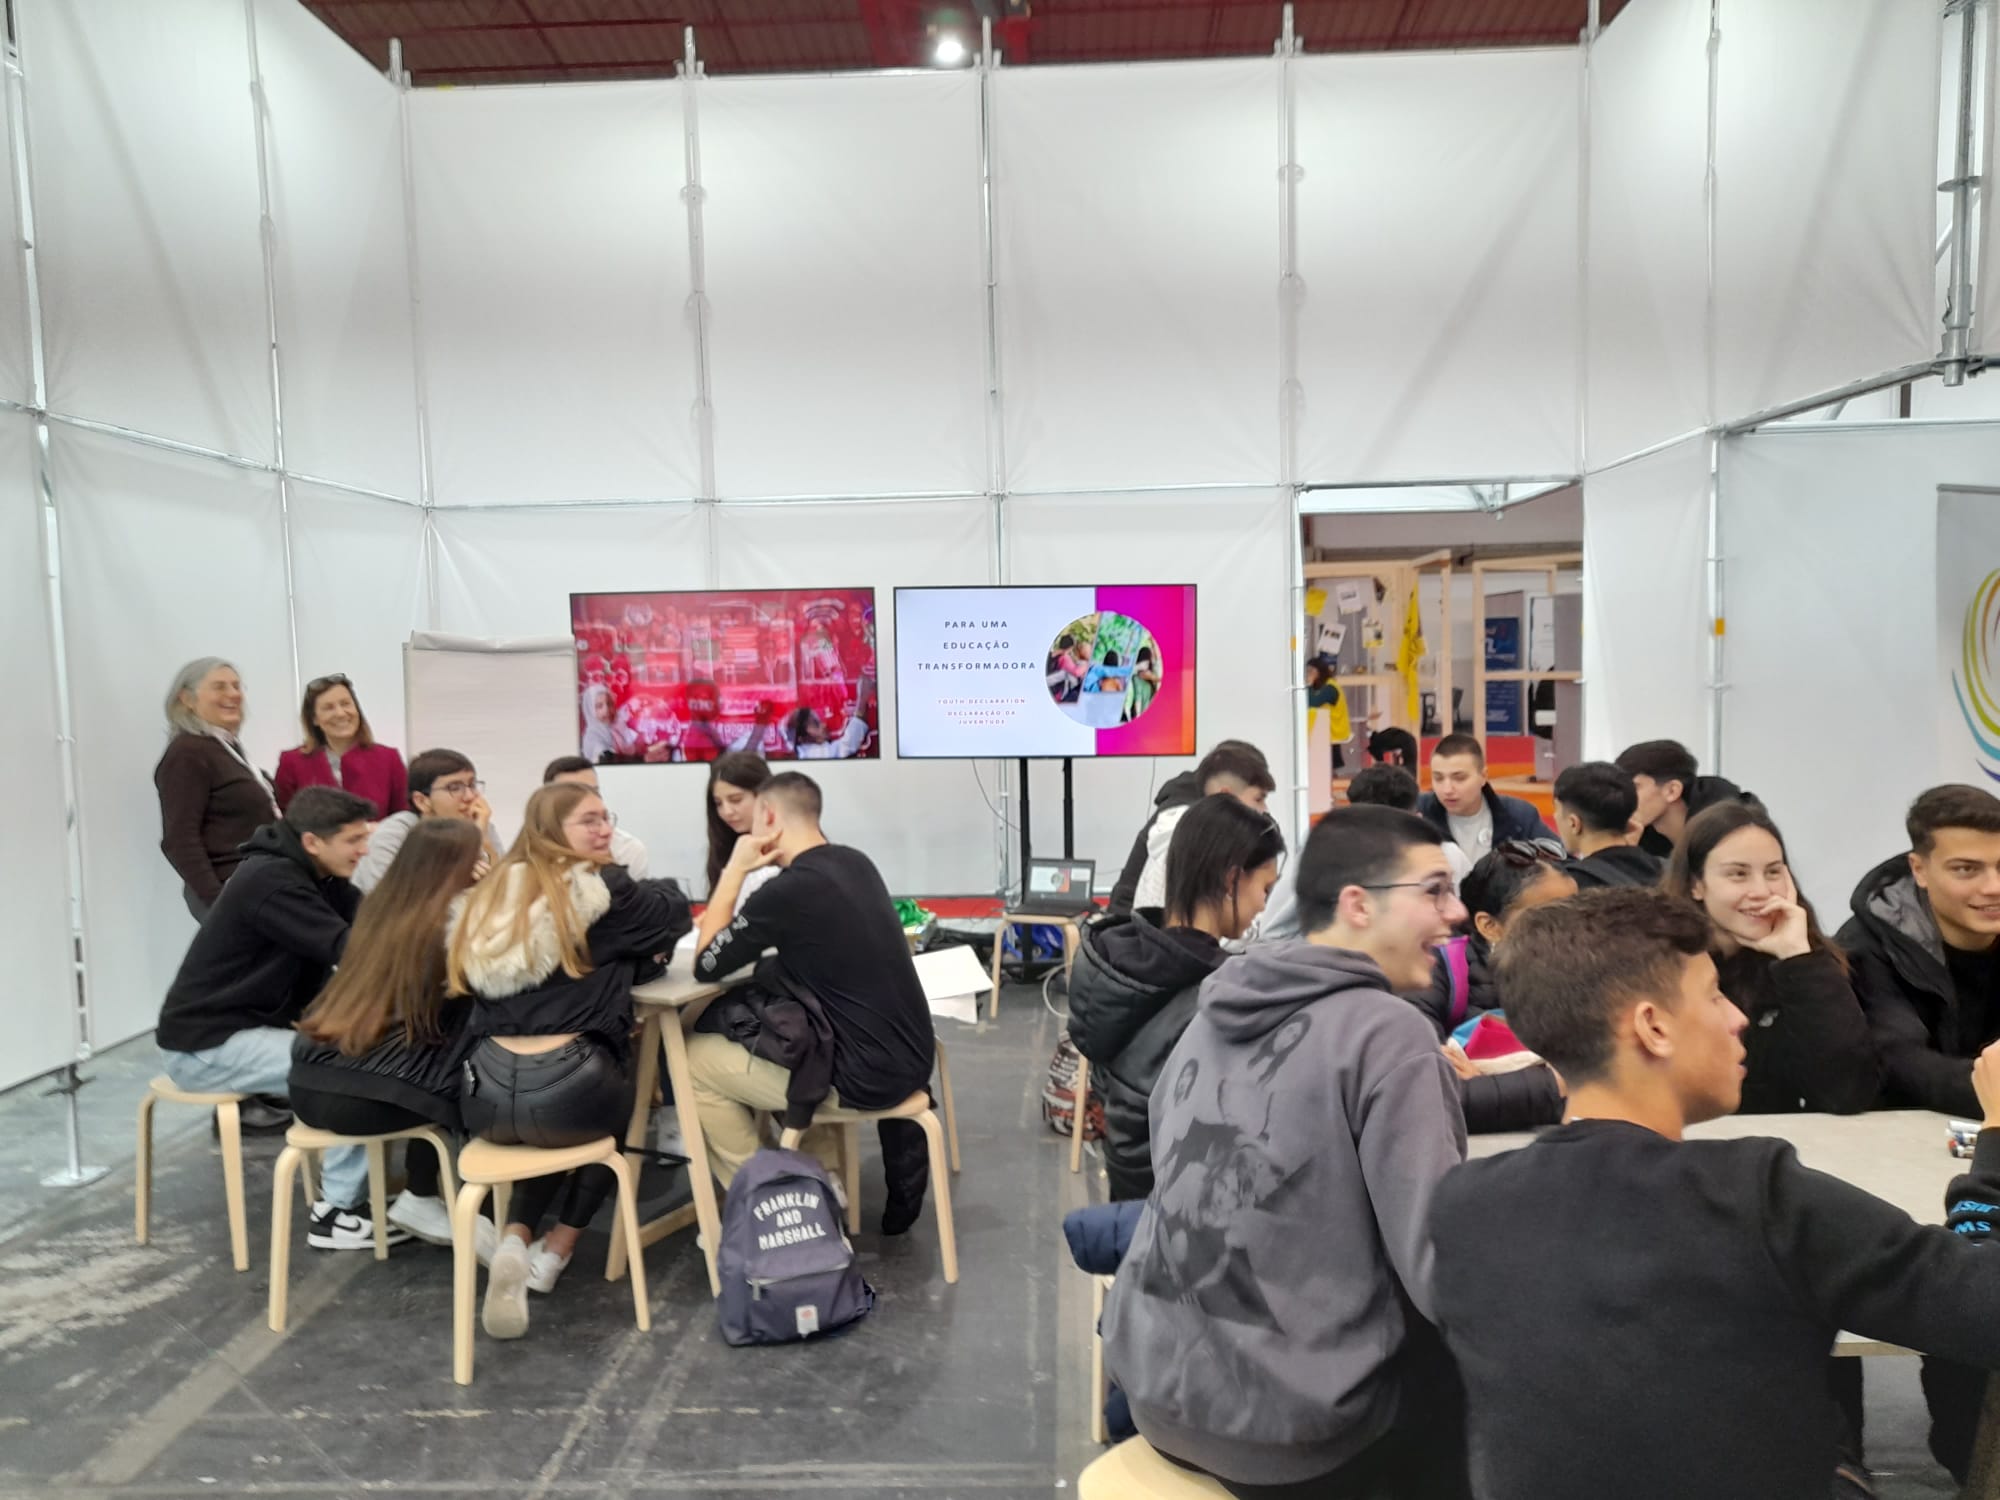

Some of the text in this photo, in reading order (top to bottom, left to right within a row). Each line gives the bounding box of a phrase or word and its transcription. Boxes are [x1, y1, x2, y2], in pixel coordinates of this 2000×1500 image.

[944, 620, 1008, 629] PARA UMA
[943, 640, 1010, 651] EDUCAÇÃO
[917, 662, 1036, 671] TRANSFORMADORA
[753, 1192, 820, 1221] FRANKLIN
[776, 1208, 802, 1228] AND
[758, 1221, 827, 1250] MARSHALL
